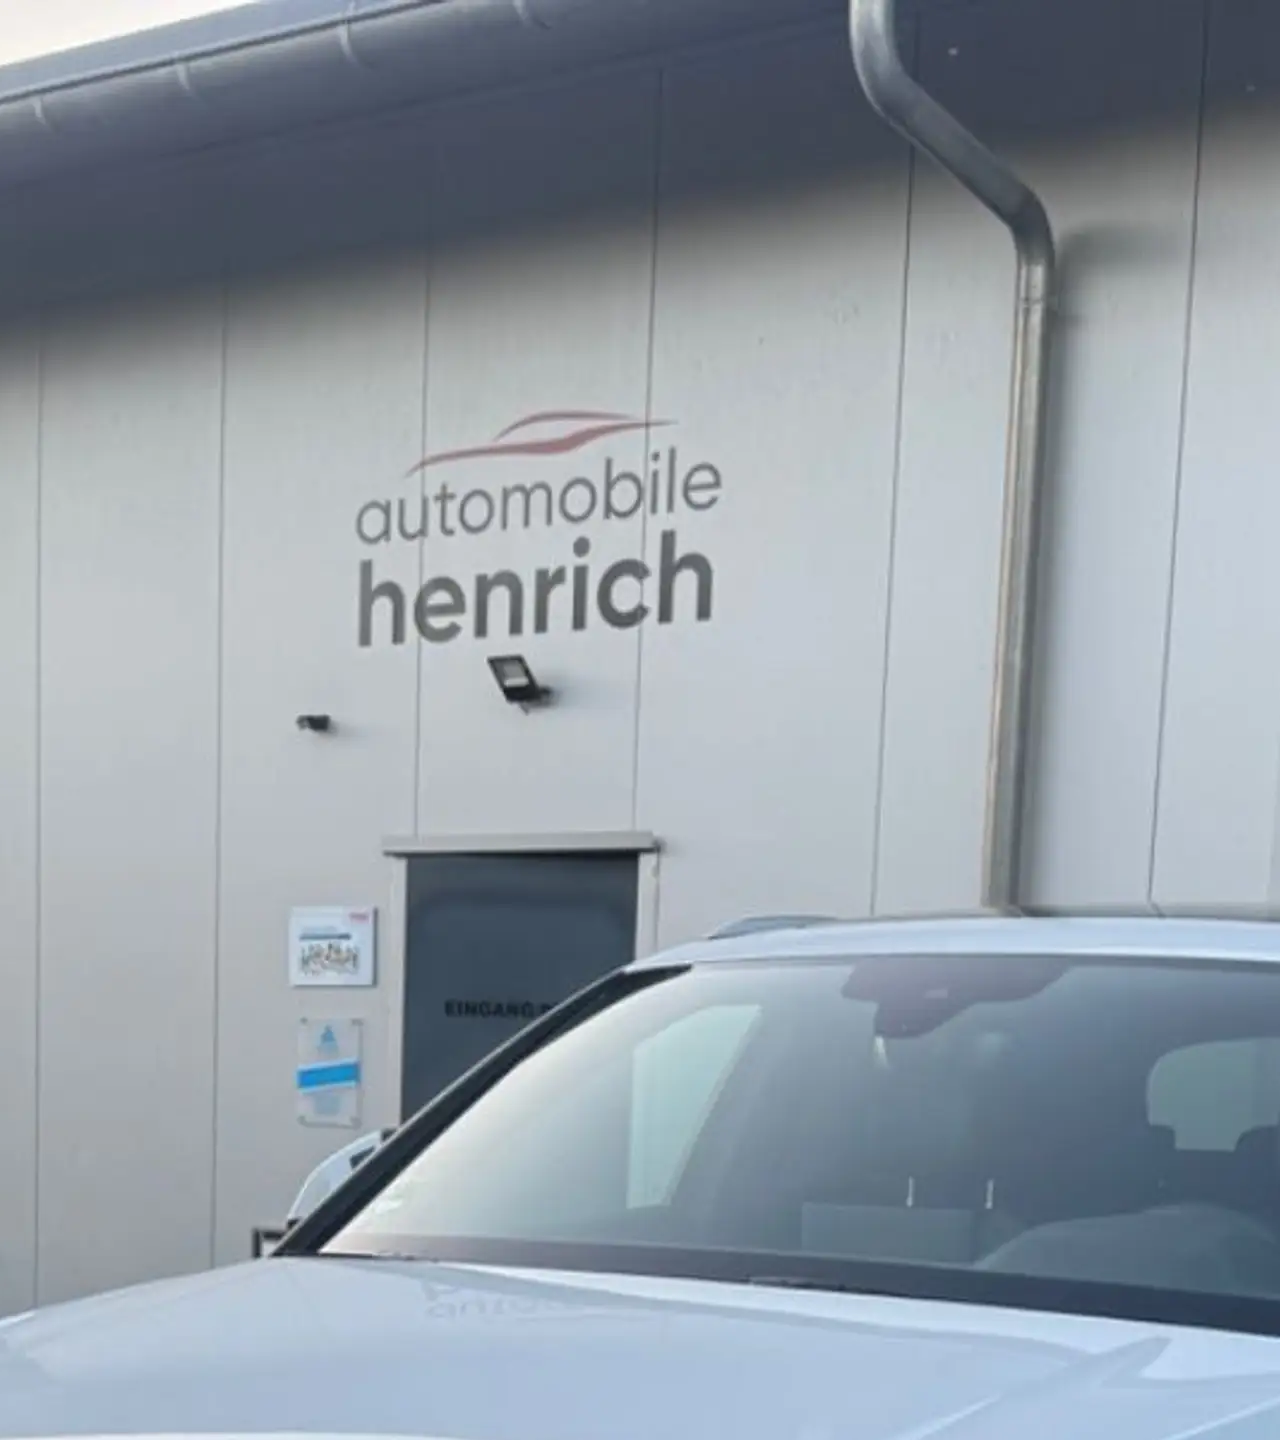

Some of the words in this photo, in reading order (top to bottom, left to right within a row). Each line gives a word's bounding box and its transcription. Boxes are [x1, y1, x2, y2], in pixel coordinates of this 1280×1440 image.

[355, 447, 722, 545] automobile
[357, 529, 714, 648] henrich
[444, 999, 535, 1018] EINGANG
